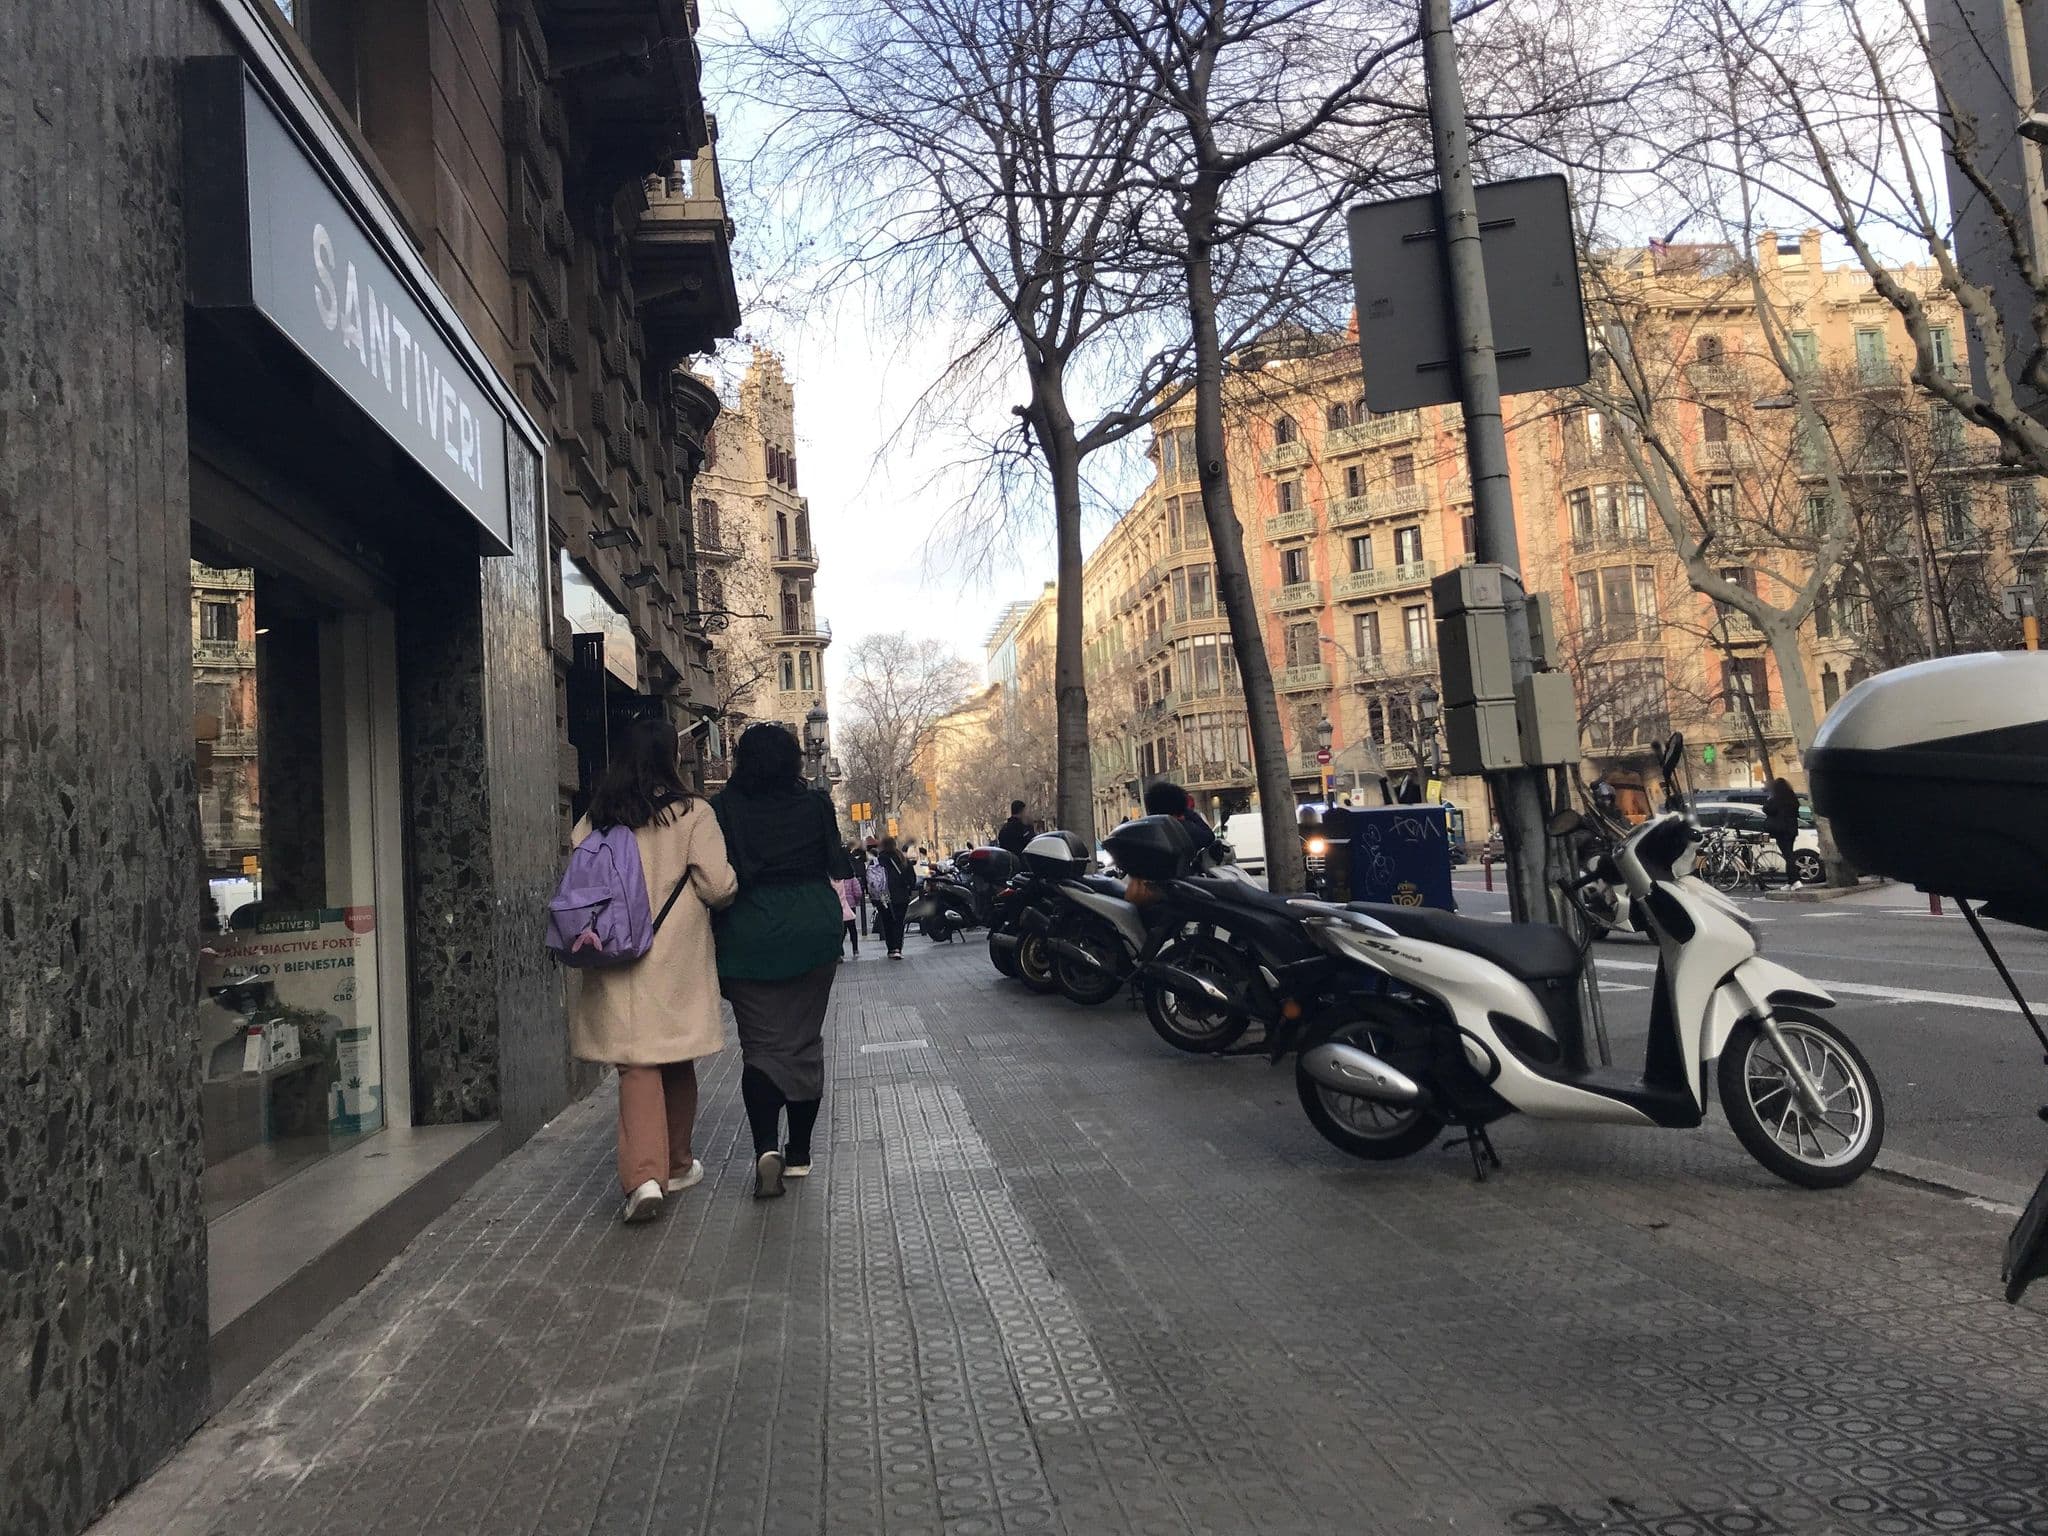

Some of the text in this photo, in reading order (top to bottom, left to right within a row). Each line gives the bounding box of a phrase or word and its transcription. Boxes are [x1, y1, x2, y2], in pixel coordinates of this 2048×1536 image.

[312, 223, 483, 490] SANTIVERI
[258, 920, 314, 932] SANTIVERI
[322, 937, 361, 949] FORTE
[272, 963, 280, 974] Y
[284, 957, 355, 973] BIENESTAR
[333, 993, 353, 1002] CBD
